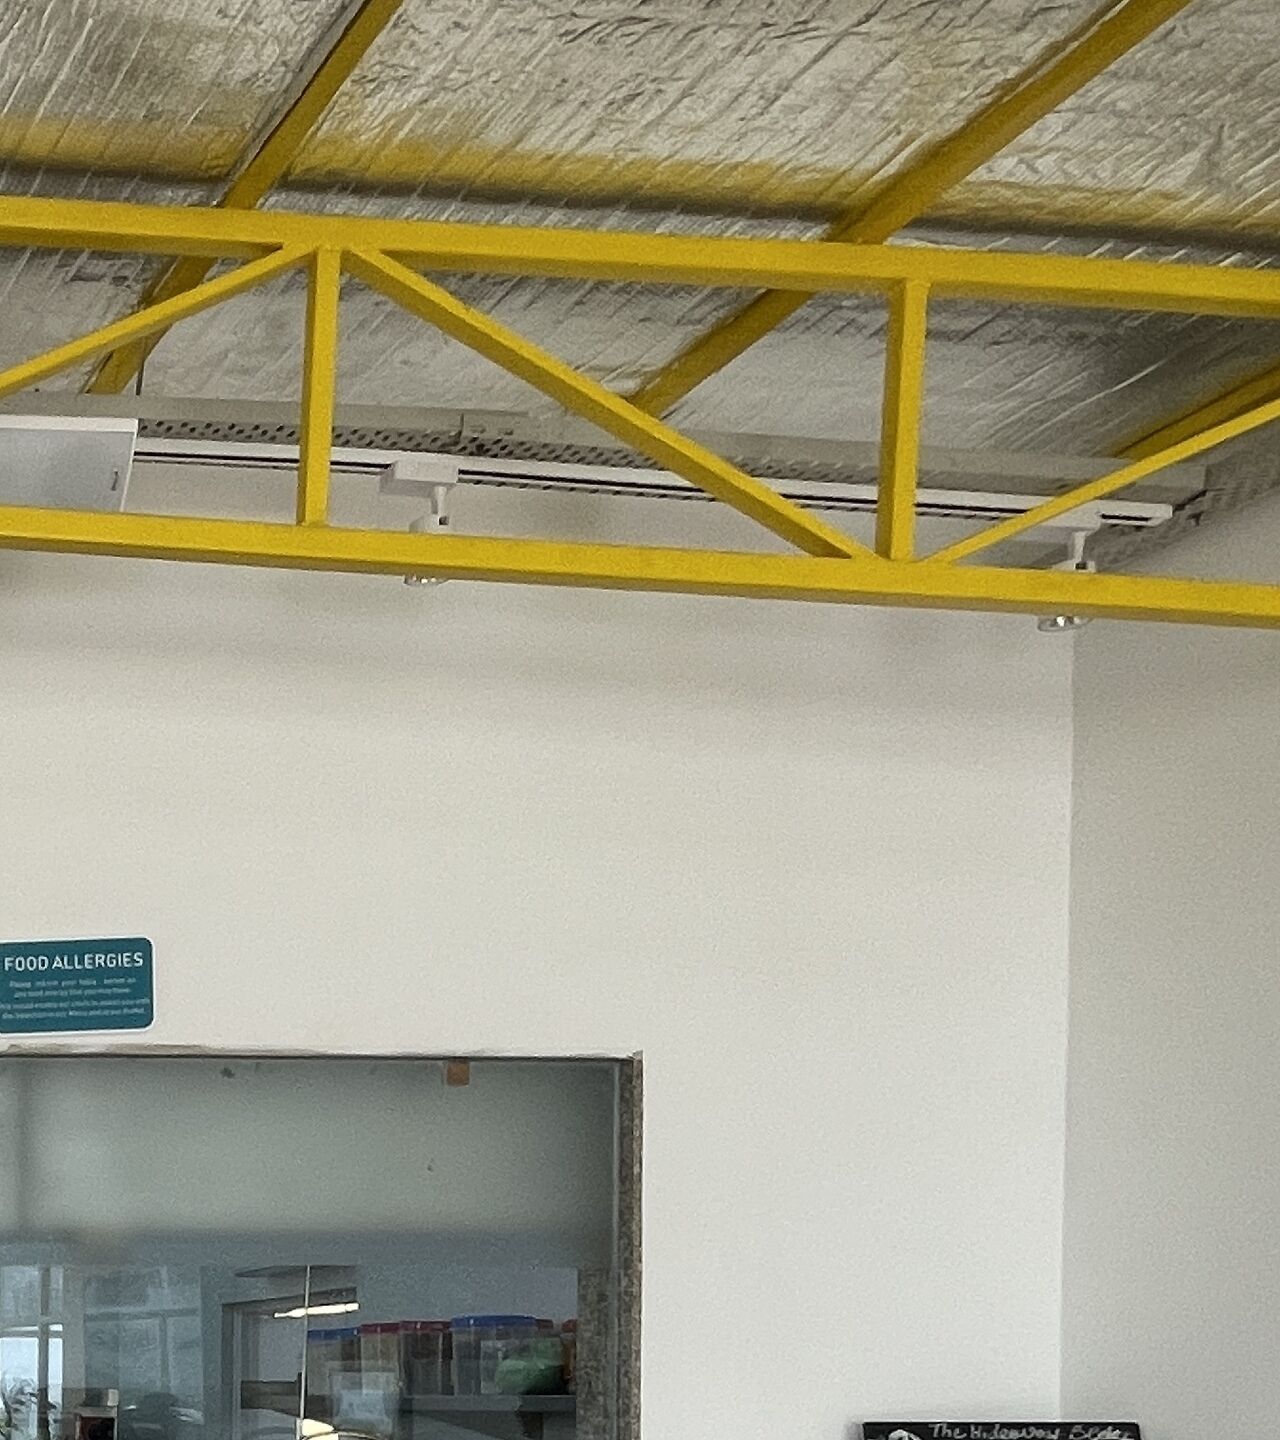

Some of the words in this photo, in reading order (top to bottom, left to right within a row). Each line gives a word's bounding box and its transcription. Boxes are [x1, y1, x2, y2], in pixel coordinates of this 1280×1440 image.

[4, 956, 48, 972] FOOD
[52, 952, 144, 970] ALLERGIES
[928, 1422, 967, 1439] The
